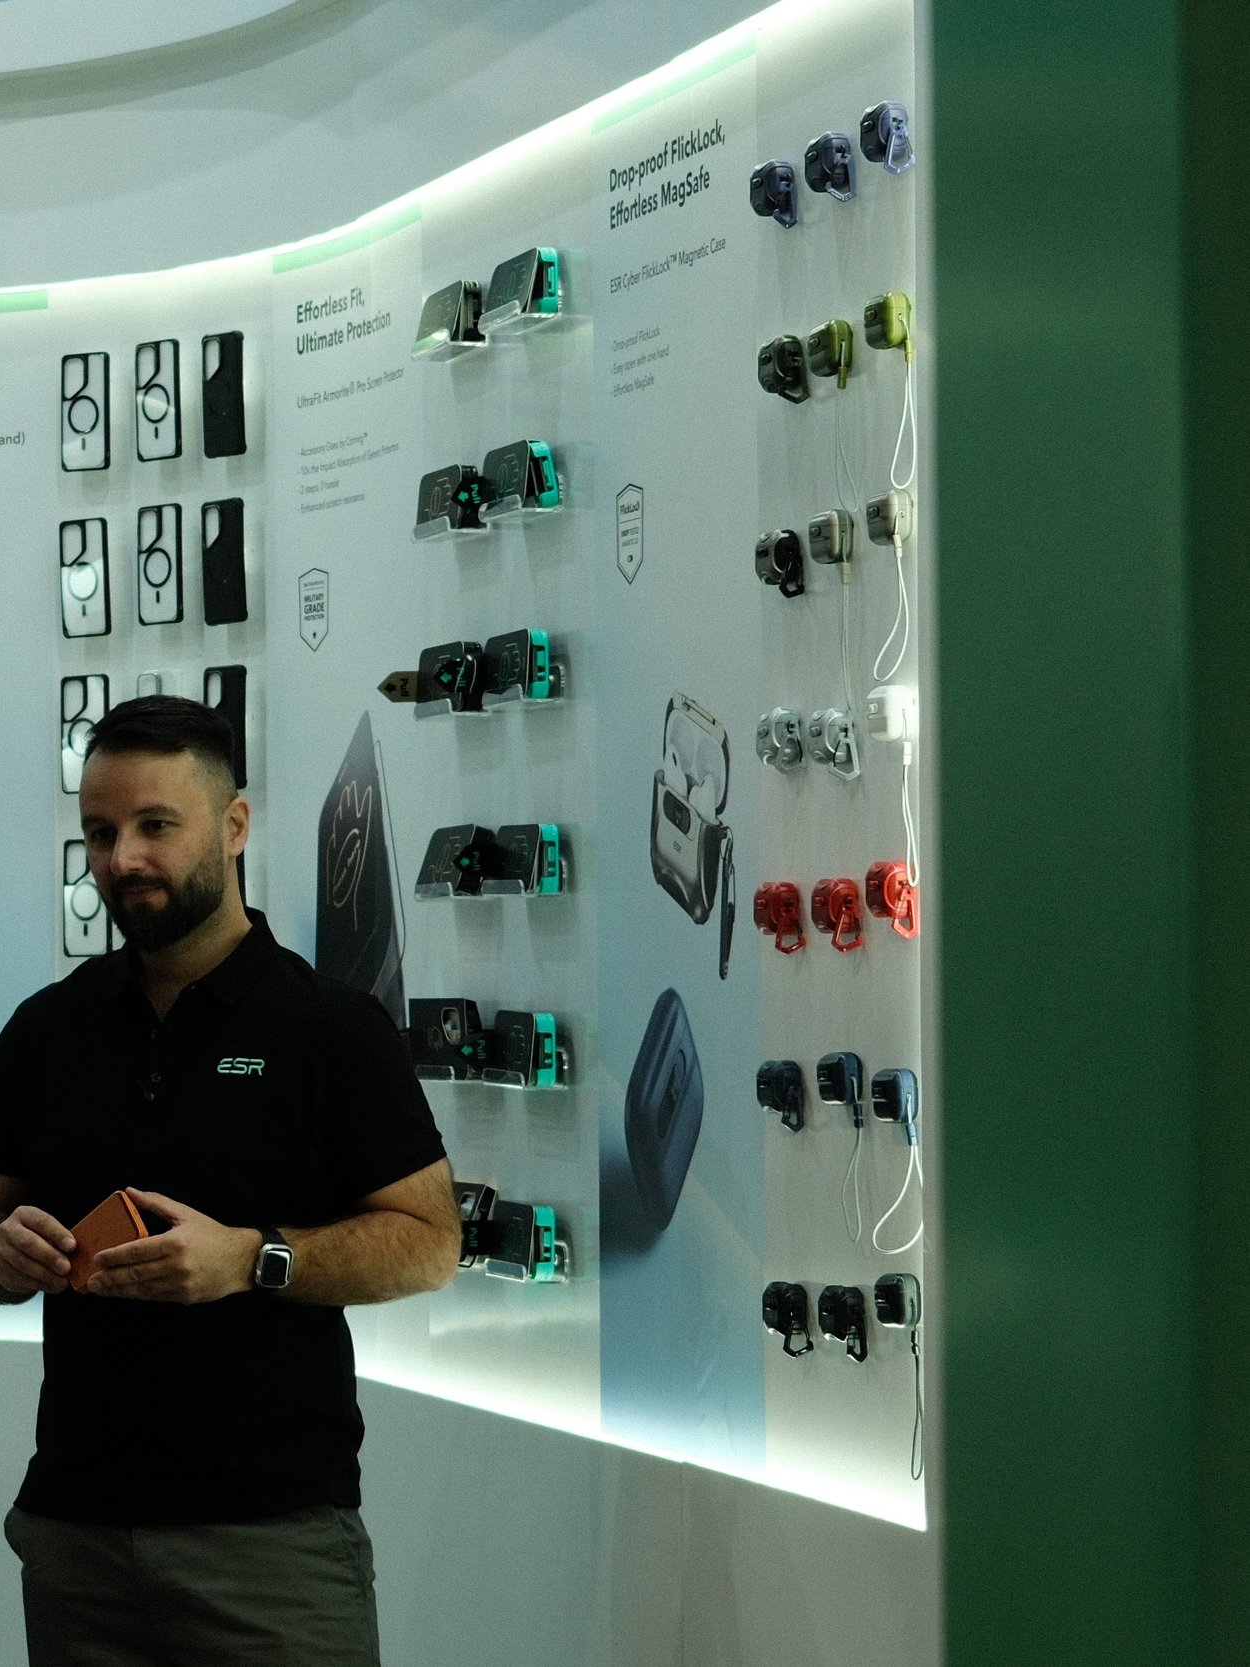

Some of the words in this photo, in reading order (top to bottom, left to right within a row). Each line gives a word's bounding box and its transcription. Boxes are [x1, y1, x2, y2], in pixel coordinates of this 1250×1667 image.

[610, 142, 668, 192] Drop-proof
[671, 118, 726, 164] FlickLock,
[610, 193, 658, 230] Effortless
[661, 165, 710, 208] MagSafe
[610, 276, 622, 294] ESR
[622, 272, 640, 291] Cyber
[678, 243, 709, 267] Magnetic
[710, 238, 726, 254] Case
[296, 296, 348, 324] Effortless
[350, 287, 365, 308] Fit,
[296, 328, 344, 355] Ultimate
[347, 310, 390, 342] Protection
[470, 484, 481, 504] Pull
[304, 602, 325, 614] GRADE
[400, 678, 409, 697] Pull
[476, 1039, 486, 1060] Pull
[217, 1057, 265, 1076] ESR
